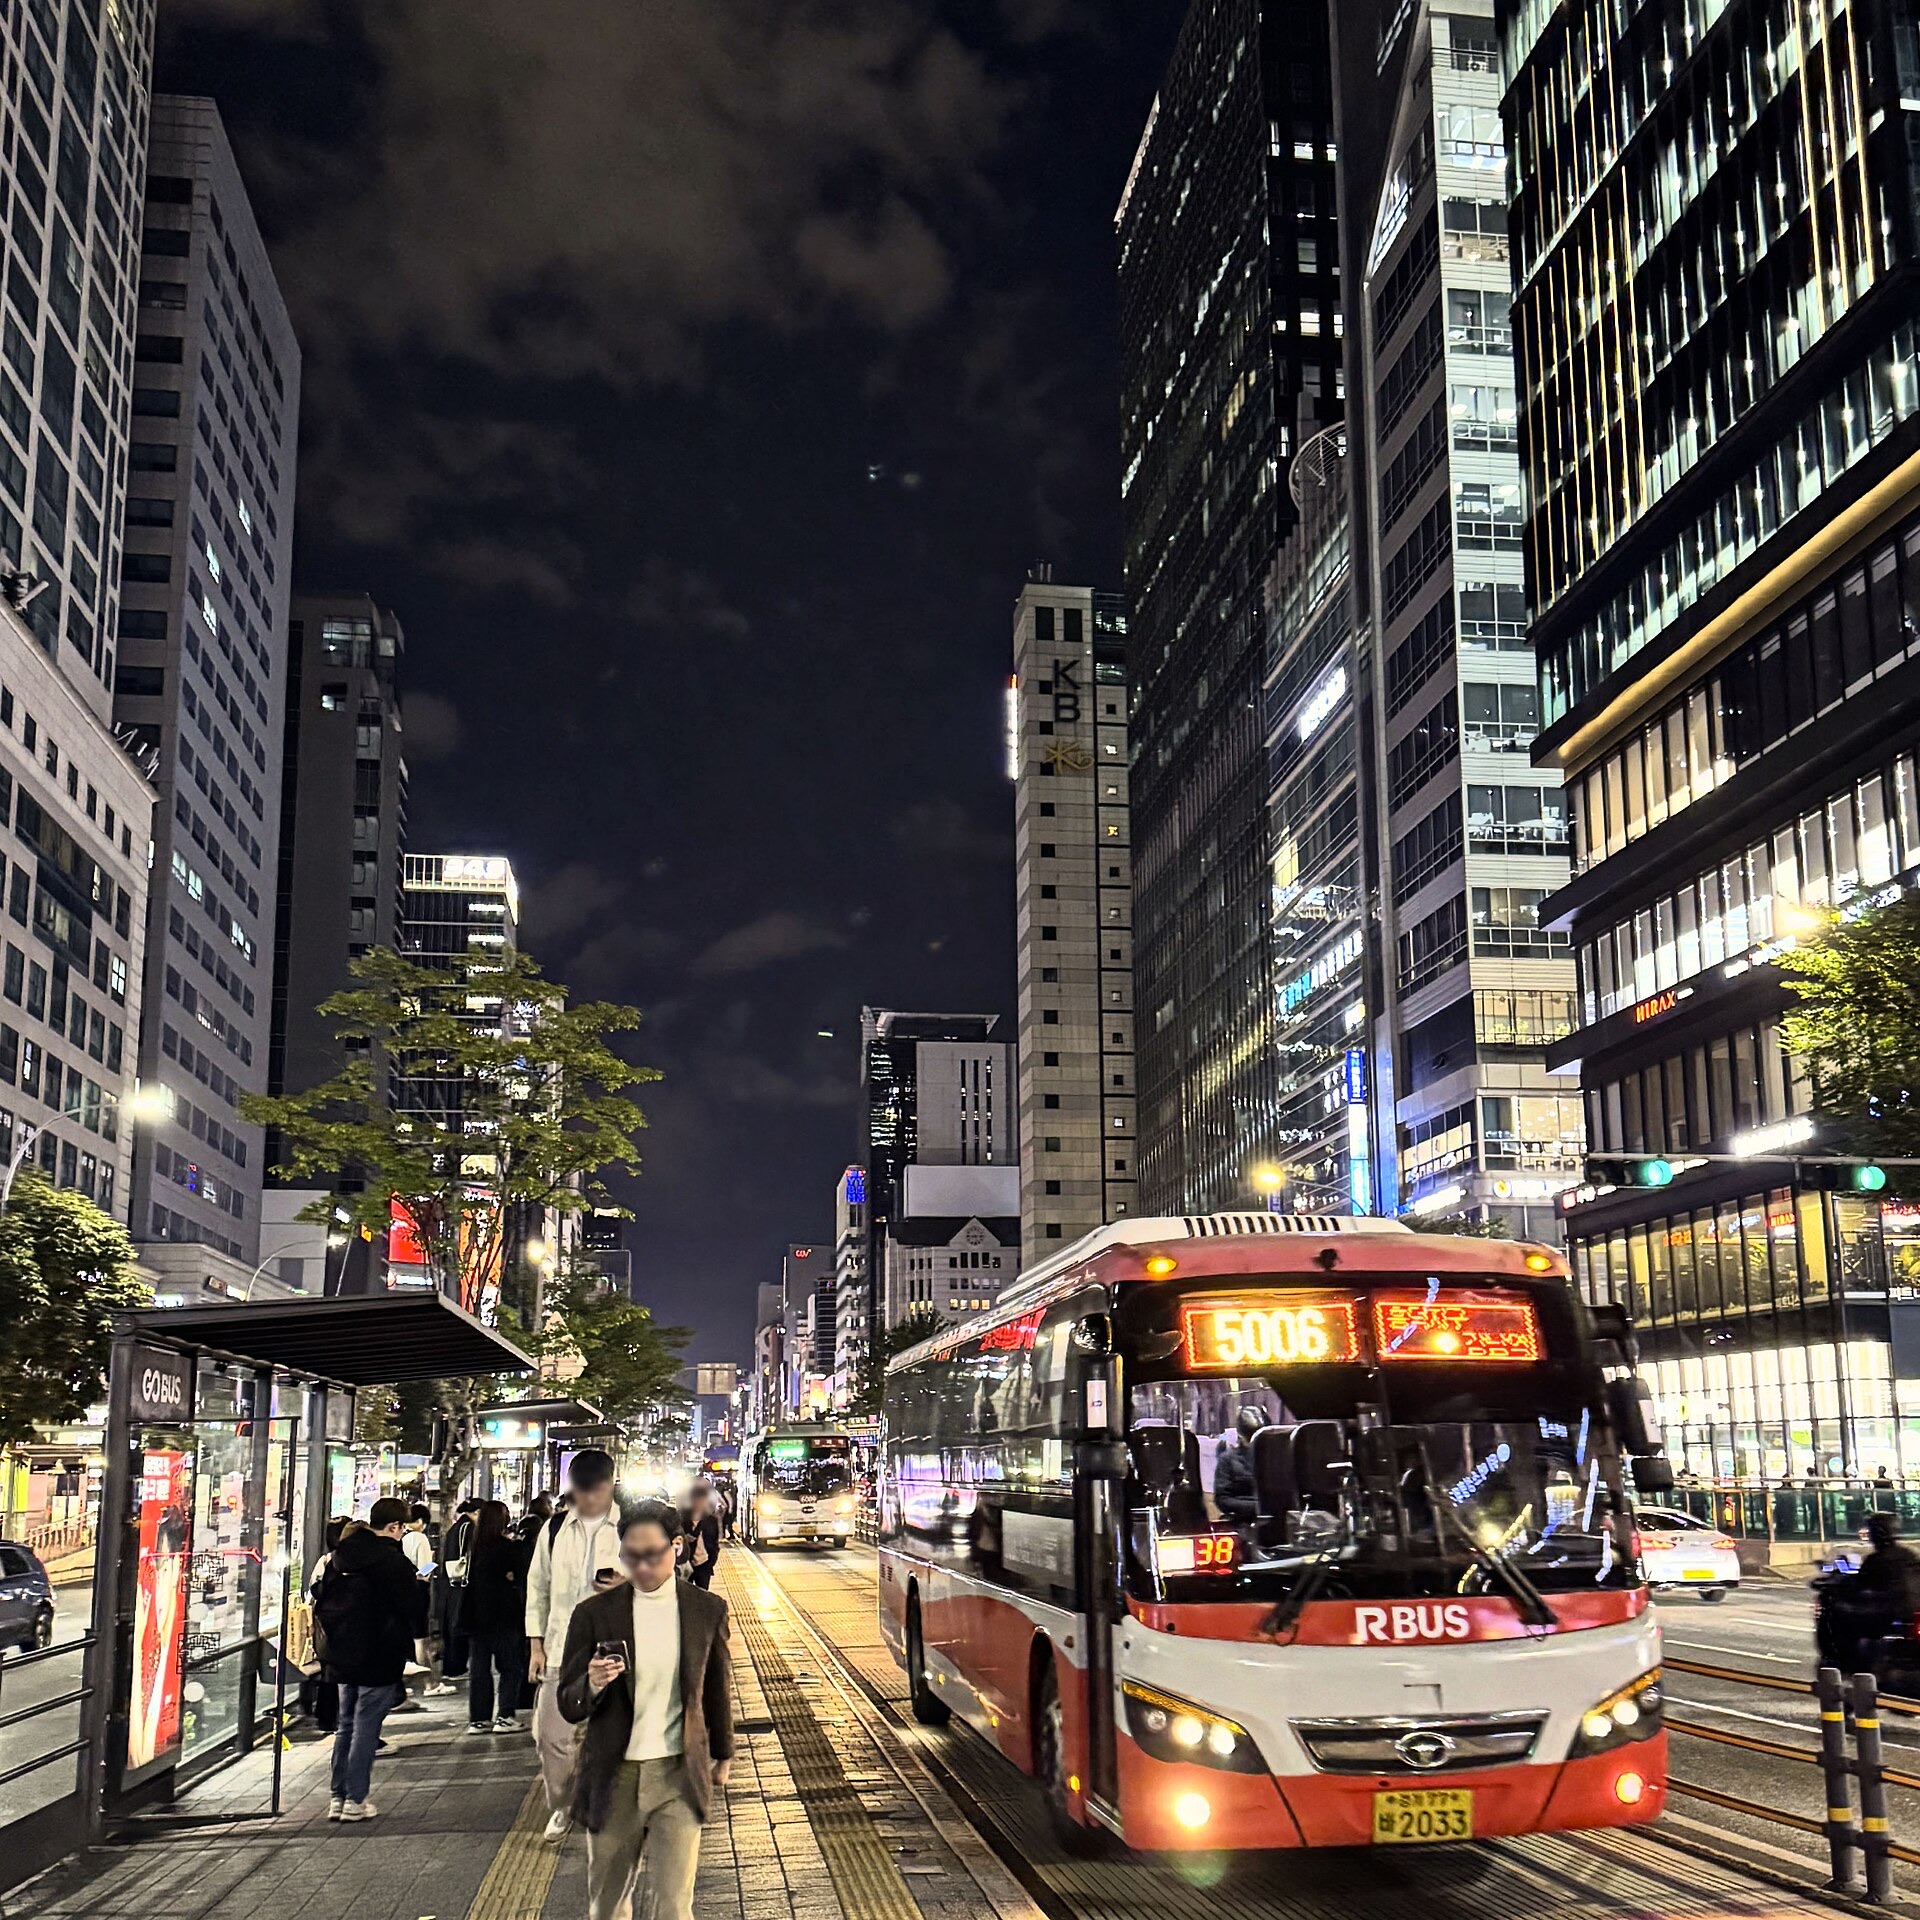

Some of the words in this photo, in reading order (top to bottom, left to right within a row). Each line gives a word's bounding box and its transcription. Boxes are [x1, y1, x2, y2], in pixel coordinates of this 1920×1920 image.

[1635, 990, 1676, 1023] HIRAX
[1213, 1308, 1329, 1362] 5006
[1196, 1536, 1234, 1566] 38
